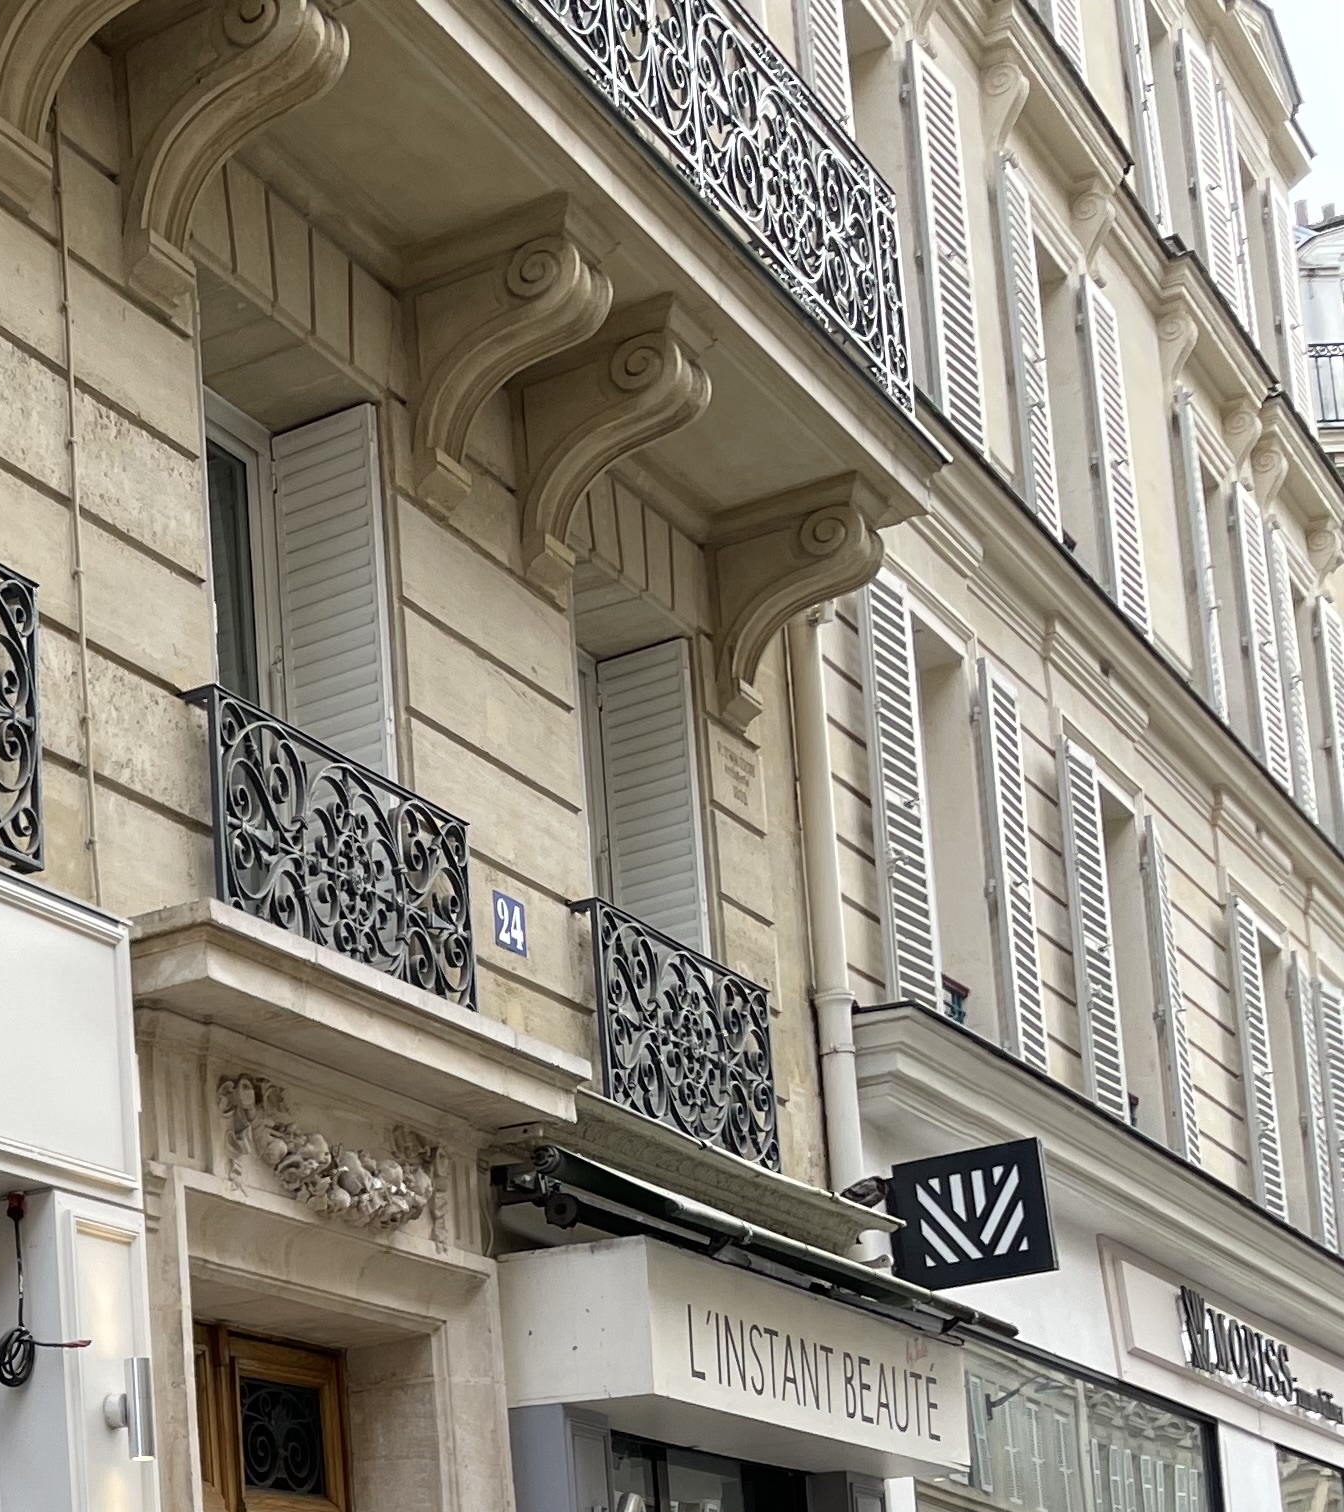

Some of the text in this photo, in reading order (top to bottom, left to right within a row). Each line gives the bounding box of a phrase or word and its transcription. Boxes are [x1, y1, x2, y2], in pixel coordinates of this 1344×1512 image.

[496, 897, 524, 951] 24
[687, 1303, 942, 1442] L'INSTANT BEAUTÉ
